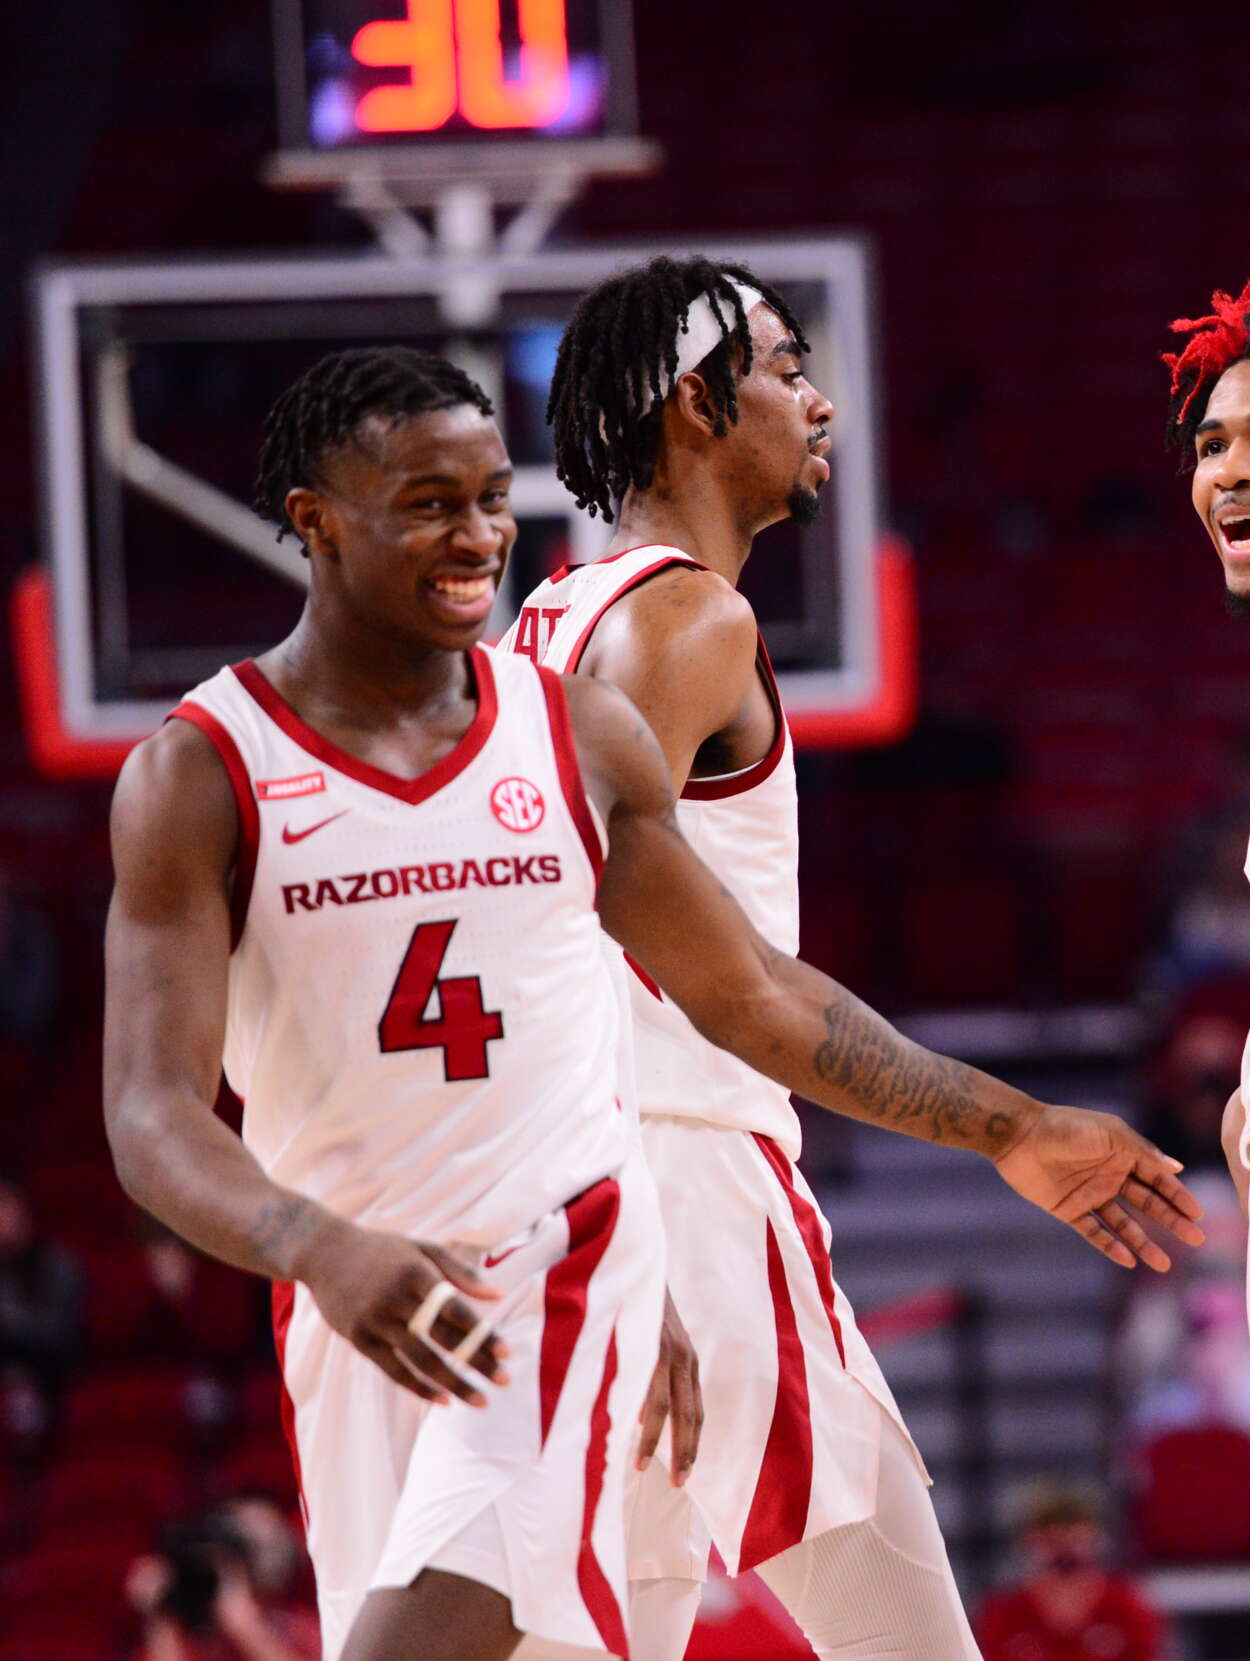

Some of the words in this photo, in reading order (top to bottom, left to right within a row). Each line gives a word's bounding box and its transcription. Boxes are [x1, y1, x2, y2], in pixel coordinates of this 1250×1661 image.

[493, 779, 543, 829] SEC
[282, 855, 562, 914] RAZORBACKS
[378, 918, 504, 1082] 4
